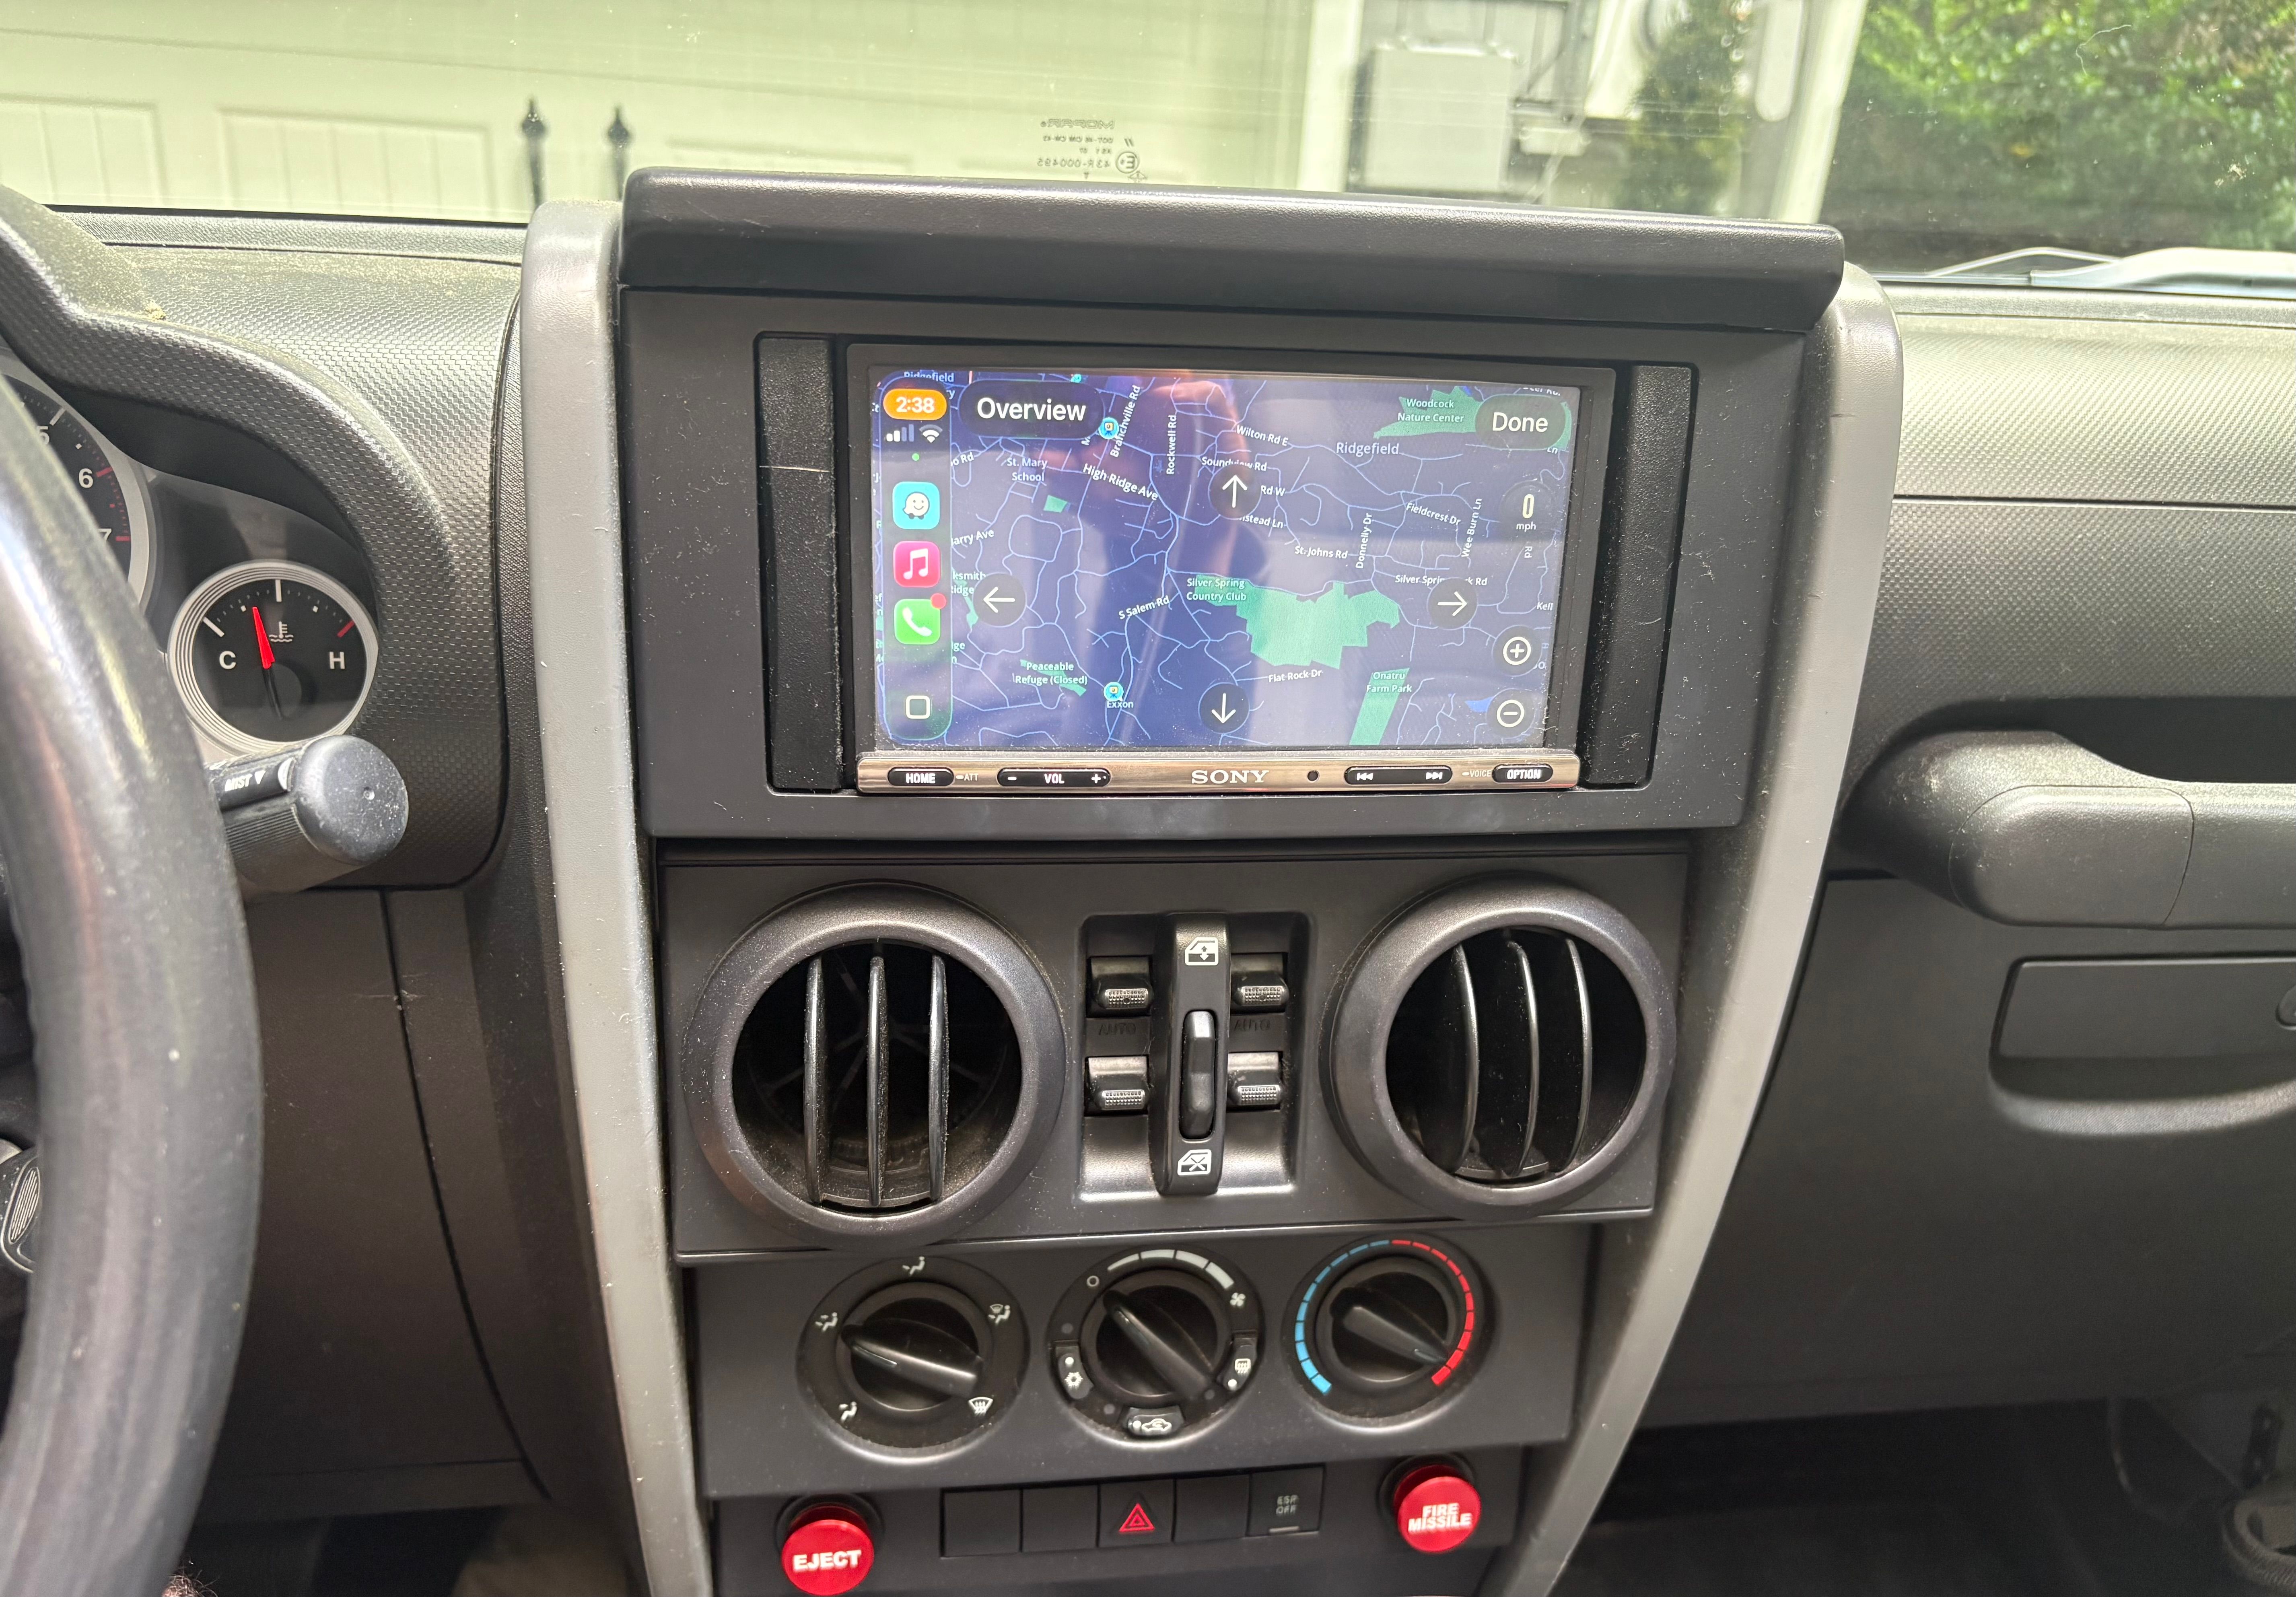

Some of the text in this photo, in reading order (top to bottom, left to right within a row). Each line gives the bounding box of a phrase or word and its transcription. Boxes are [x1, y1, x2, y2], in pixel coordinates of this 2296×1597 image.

[896, 396, 935, 413] 2:38
[977, 397, 1086, 421] Overview
[1406, 398, 1455, 408] Woodcock
[1110, 385, 1141, 457] Branchville Rd
[1398, 412, 1464, 422] Nature Center
[1492, 412, 1548, 433] Done
[1237, 425, 1289, 446] Wilton Rd E
[1166, 415, 1177, 475] Rockwell Rd
[1336, 442, 1400, 457] Ridgefield
[960, 451, 974, 464] Rd
[1007, 457, 1048, 470] St. Mary
[1254, 462, 1267, 472] Rd
[78, 468, 94, 488] 6
[1012, 472, 1044, 482] School
[1083, 463, 1159, 501] High Ridge Ave
[1261, 485, 1285, 497] Rd W
[1522, 494, 1534, 519] 0
[1406, 502, 1461, 526] Fieldcrest Dr
[1272, 520, 1284, 528] Ln
[1461, 498, 1483, 558] Wee Burn Ln
[1516, 522, 1536, 532] mph
[976, 530, 995, 540] Ave
[1355, 513, 1372, 569] Donnelly Dr
[1294, 545, 1348, 559] St. Johns Rd
[1524, 546, 1532, 558] Rd
[953, 571, 986, 580] ksmith
[1394, 574, 1420, 583] Silver
[1422, 575, 1445, 586] Spri
[1475, 577, 1488, 585] Rd
[1186, 578, 1246, 589] Silver Spring
[1186, 591, 1246, 603] Country Club
[1118, 595, 1170, 620] S Salem Rd
[218, 651, 345, 670] C H
[1026, 662, 1074, 671] Peaceable
[1015, 675, 1088, 686] Refuge (Closed)
[1268, 668, 1322, 683] Flat Rock Dr
[1373, 672, 1405, 680] Onatru
[1366, 684, 1413, 692] Farm Park
[1107, 701, 1134, 709] Exxon
[906, 773, 936, 784] HOME
[964, 773, 979, 781] ATT
[1044, 773, 1065, 784] VOL
[1191, 769, 1270, 784] SONY
[1507, 769, 1542, 779] OPTION
[1098, 1022, 1136, 1035] AUTO
[1234, 1018, 1271, 1031] AUTO
[1277, 1495, 1299, 1506] ESP
[1276, 1505, 1297, 1516] OFF
[1422, 1502, 1460, 1517] FIRE
[1408, 1513, 1472, 1533] MISSILE
[793, 1549, 862, 1572] EJECT
